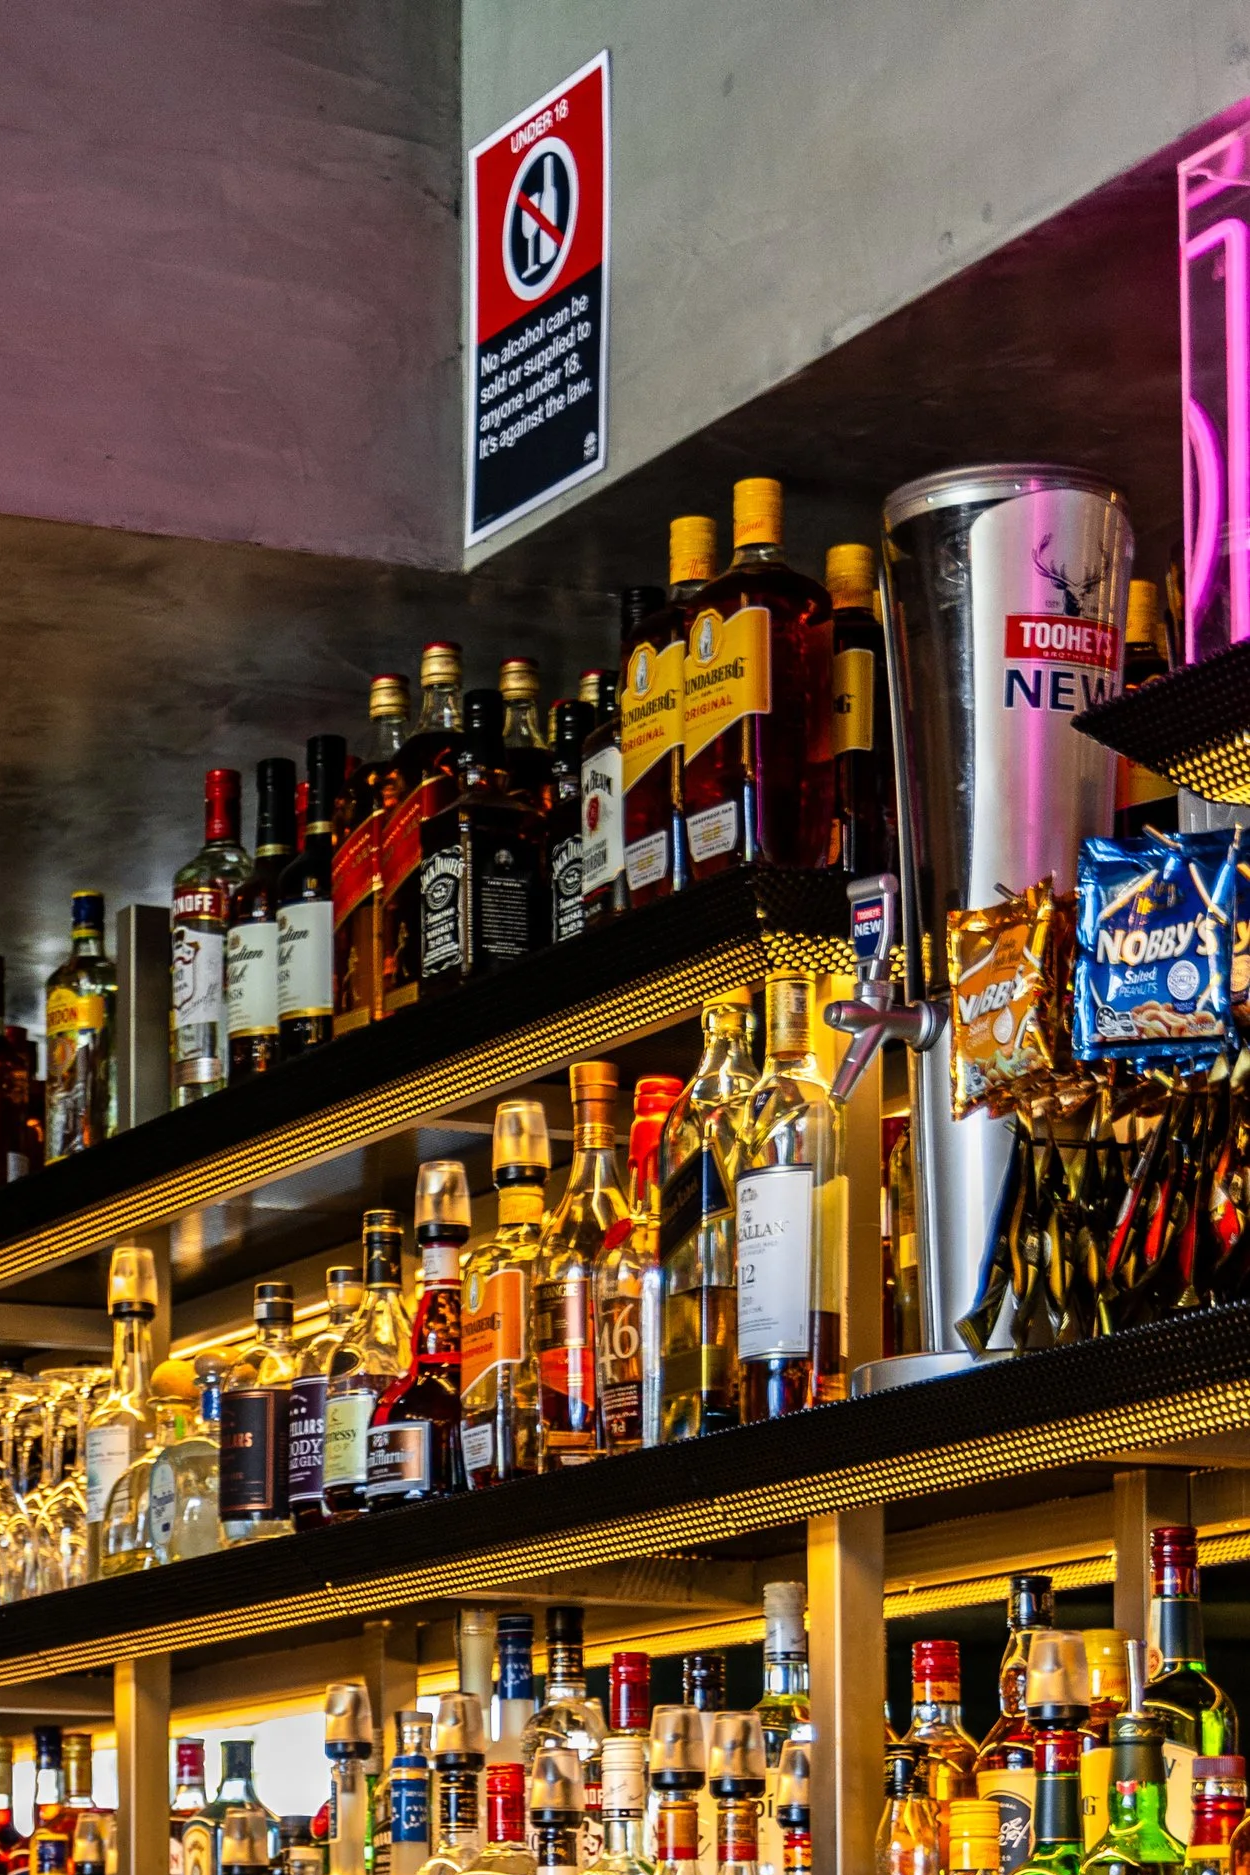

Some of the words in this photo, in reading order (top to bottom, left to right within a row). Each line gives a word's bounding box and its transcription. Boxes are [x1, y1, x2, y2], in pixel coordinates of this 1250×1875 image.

[511, 112, 553, 154] UNDER
[481, 353, 499, 377] No
[501, 318, 545, 363] alcohol
[547, 306, 570, 333] can
[571, 294, 589, 317] be
[480, 371, 507, 404] sold
[509, 364, 523, 386] or
[523, 325, 577, 376] supplied
[577, 321, 592, 341] to
[479, 392, 525, 432] anyone
[525, 366, 563, 403] under
[479, 434, 498, 460] It's
[499, 404, 546, 447] against
[545, 394, 566, 419] the
[567, 378, 593, 405] law.
[1019, 621, 1113, 657] TOOHEYS
[684, 656, 749, 696] UNDABERG
[1003, 668, 1116, 711] NEW
[621, 688, 682, 729] UNDABERG
[854, 919, 883, 937] NEW
[1096, 912, 1219, 967] NOBBY'S
[741, 1264, 756, 1286] 12
[299, 1454, 323, 1468] GIN
